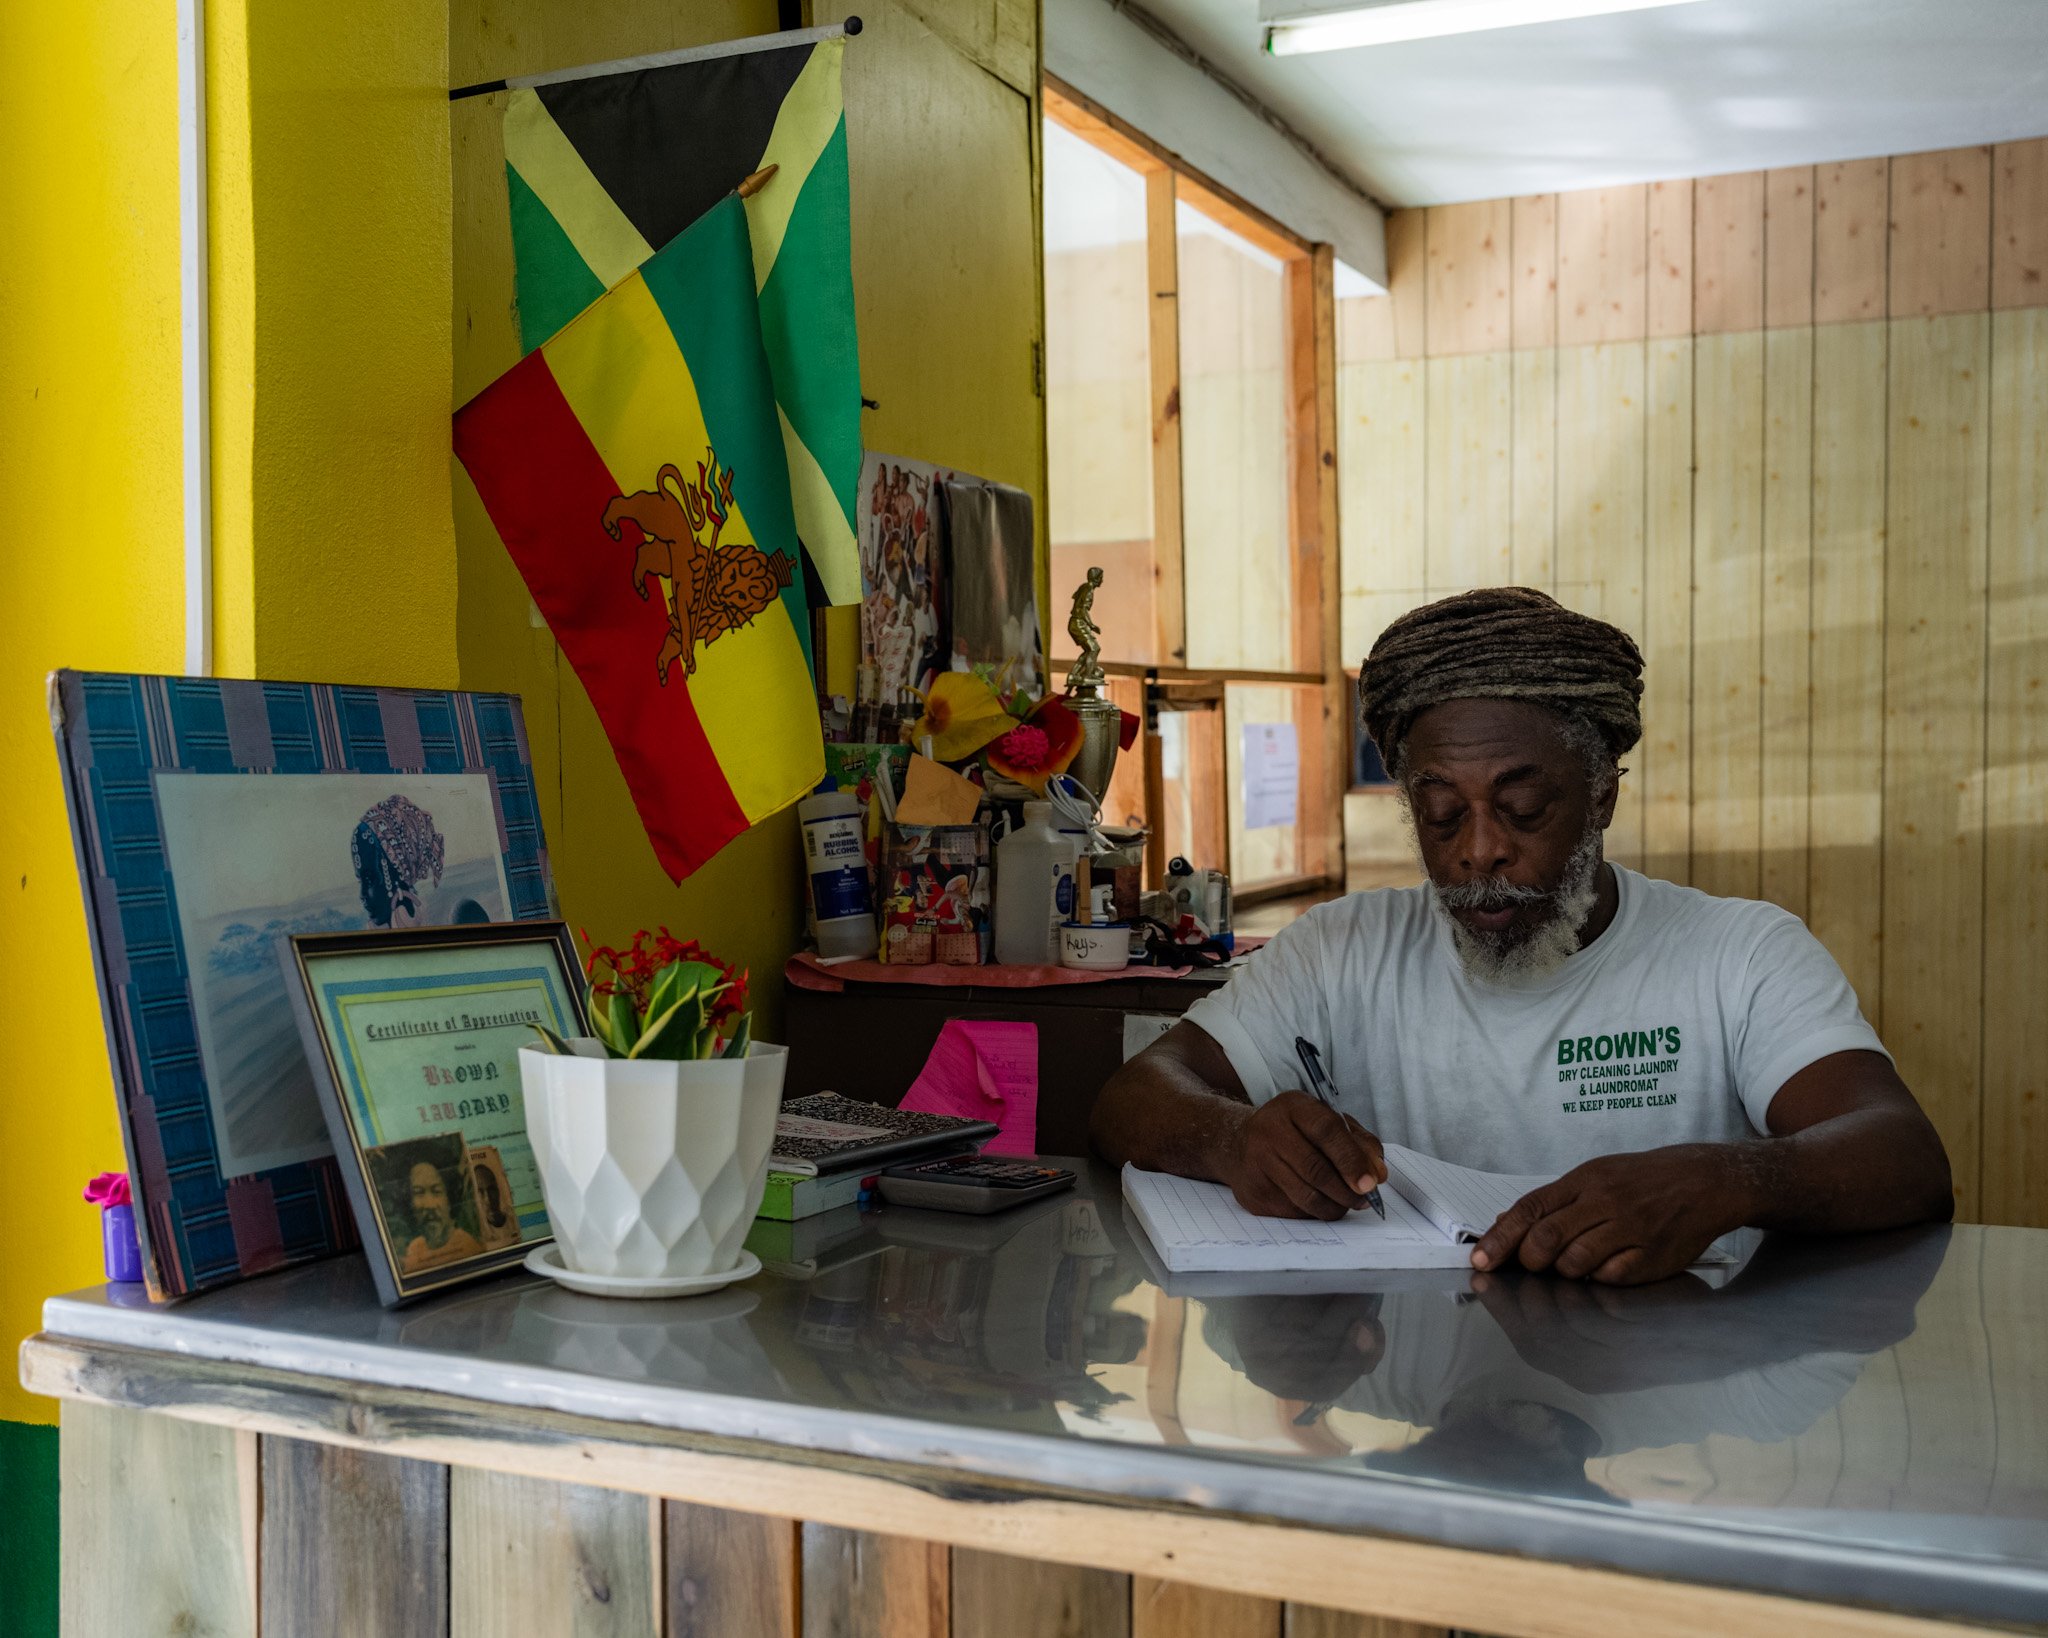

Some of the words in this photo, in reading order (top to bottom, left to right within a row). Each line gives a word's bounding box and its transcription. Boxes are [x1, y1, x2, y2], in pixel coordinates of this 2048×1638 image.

[823, 838, 859, 849] RUBBING
[825, 846, 860, 857] ALCOHOL
[366, 1021, 440, 1039] Certificate
[446, 1016, 456, 1030] of
[461, 1010, 540, 1029] Appreciation
[1557, 1026, 1681, 1065] BROWN'S
[1559, 1068, 1578, 1083] DRY
[1580, 1063, 1631, 1080] CLEANING
[1633, 1059, 1679, 1076] LAUNDRY
[1579, 1083, 1587, 1097] &
[1590, 1078, 1659, 1095] LAUNDROMAT
[417, 1093, 511, 1123] LAUNDRY
[1562, 1102, 1577, 1113] WE
[1579, 1099, 1604, 1112] KEEP
[1607, 1096, 1644, 1110] PEOPLE
[1646, 1093, 1677, 1107] CLEAN
